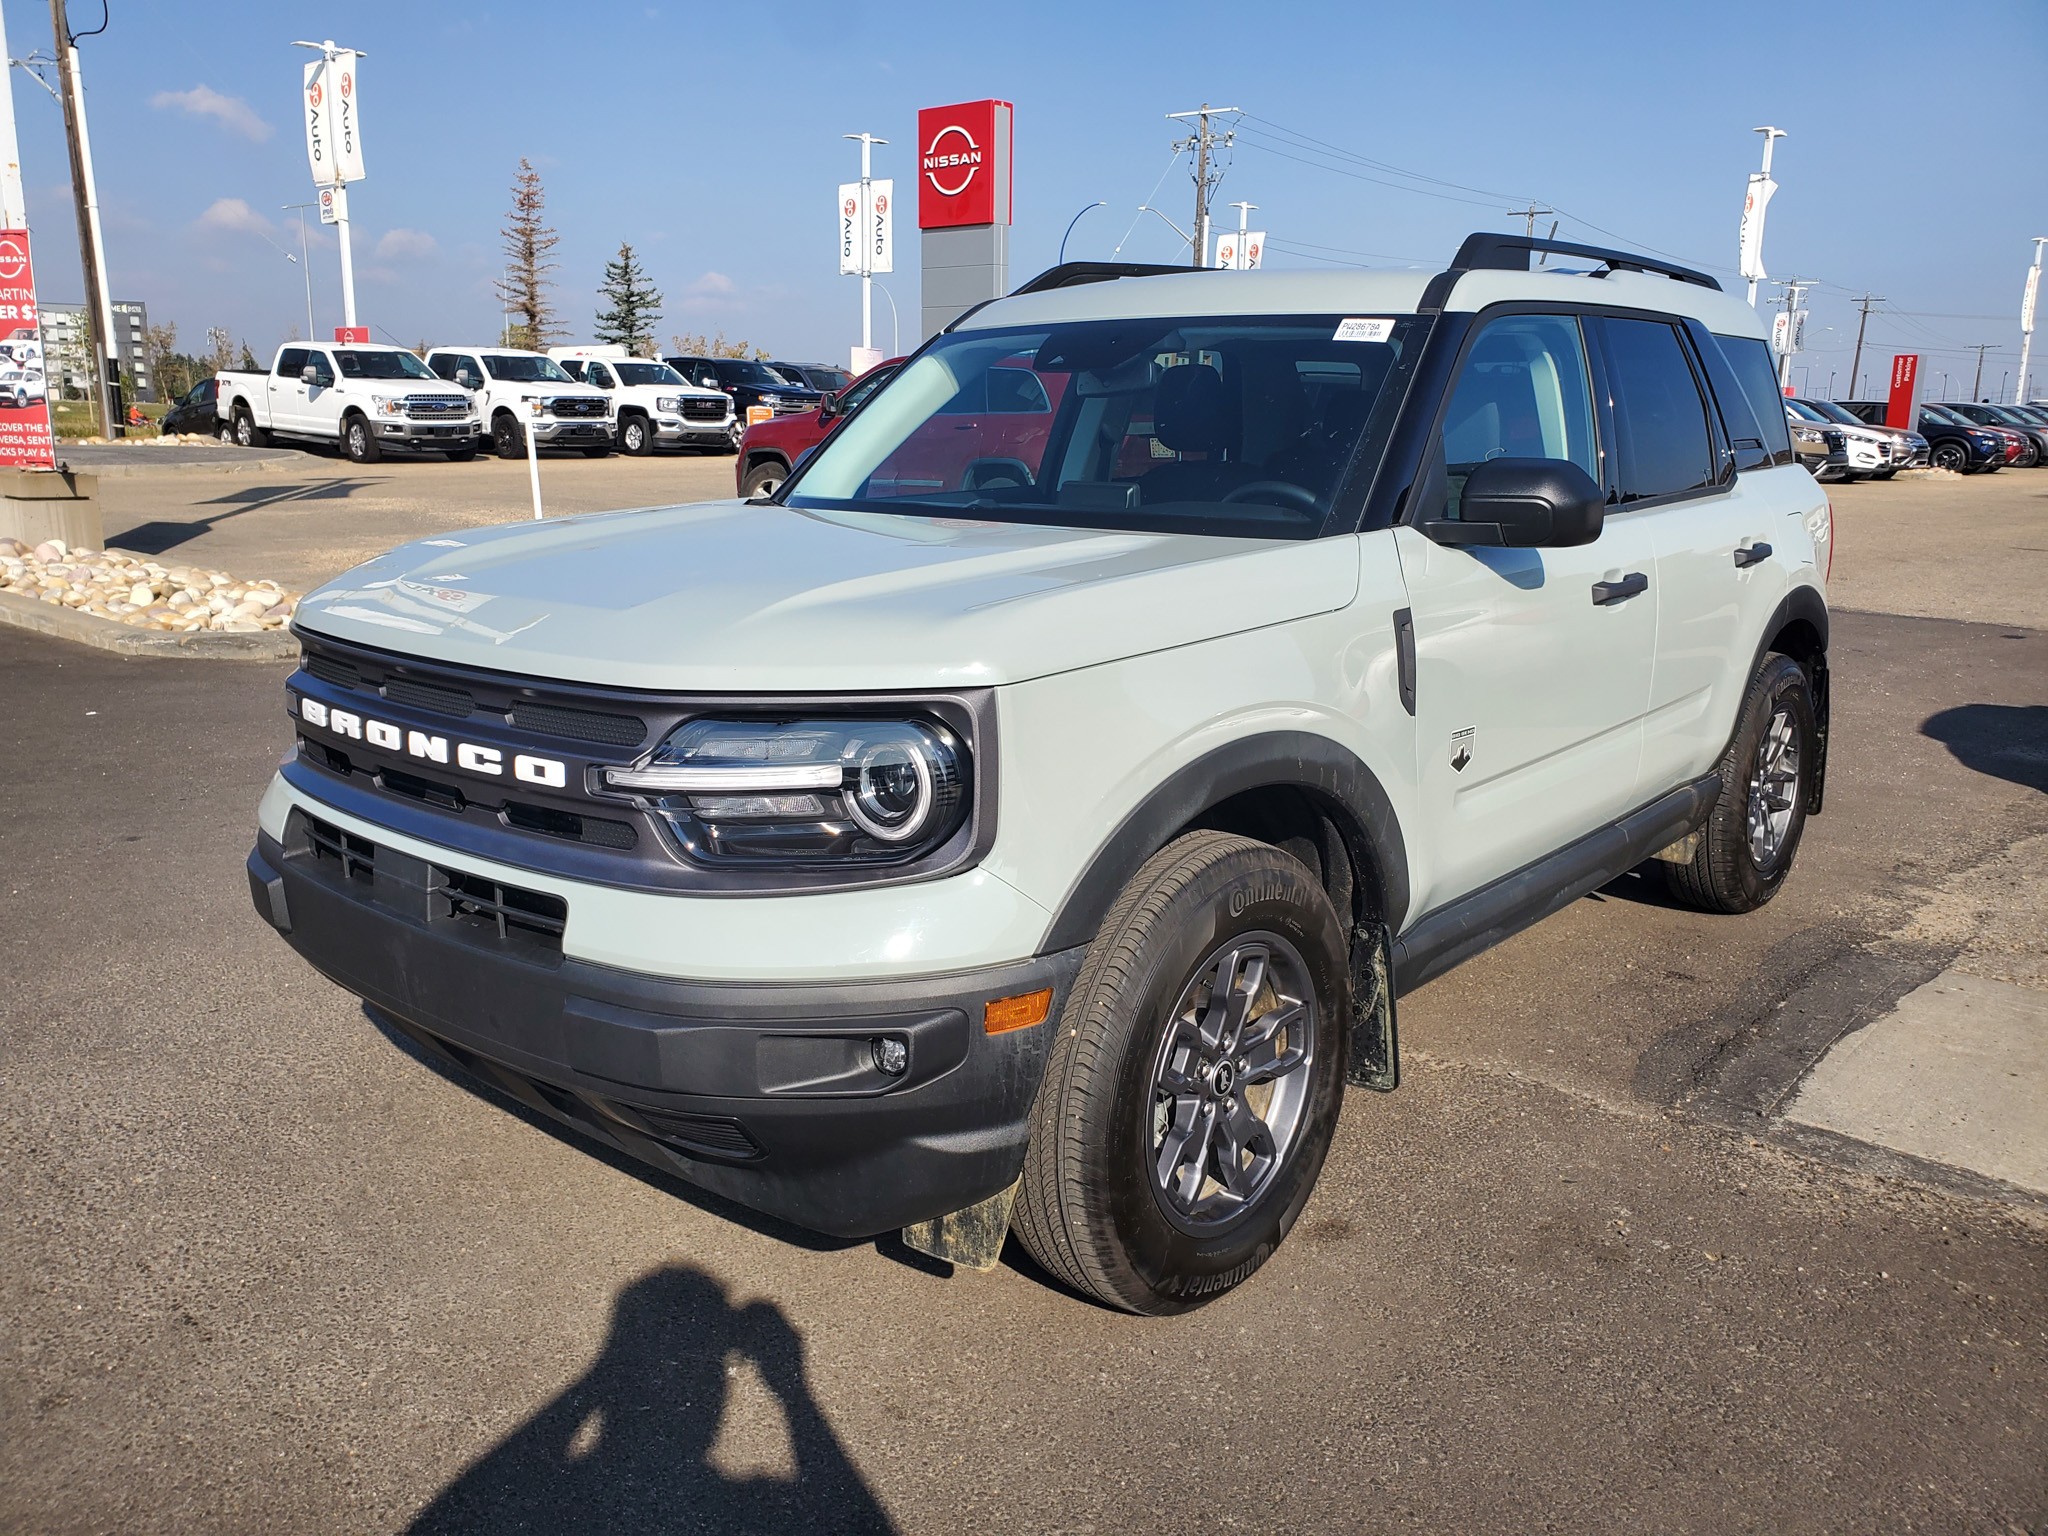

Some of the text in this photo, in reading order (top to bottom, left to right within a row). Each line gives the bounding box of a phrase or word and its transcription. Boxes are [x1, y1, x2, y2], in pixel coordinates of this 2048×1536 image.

[310, 108, 322, 162] Auto
[342, 99, 352, 154] Auto
[924, 151, 982, 169] NISSAN
[844, 218, 853, 257] Auto
[875, 215, 884, 255] Auto
[1894, 357, 1904, 388] Customer
[1903, 356, 1914, 382] Parking
[24, 423, 43, 433] THE
[0, 447, 17, 457] CKS
[17, 447, 38, 457] PLAY
[40, 448, 47, 457] &
[301, 697, 567, 788] BRONCO
